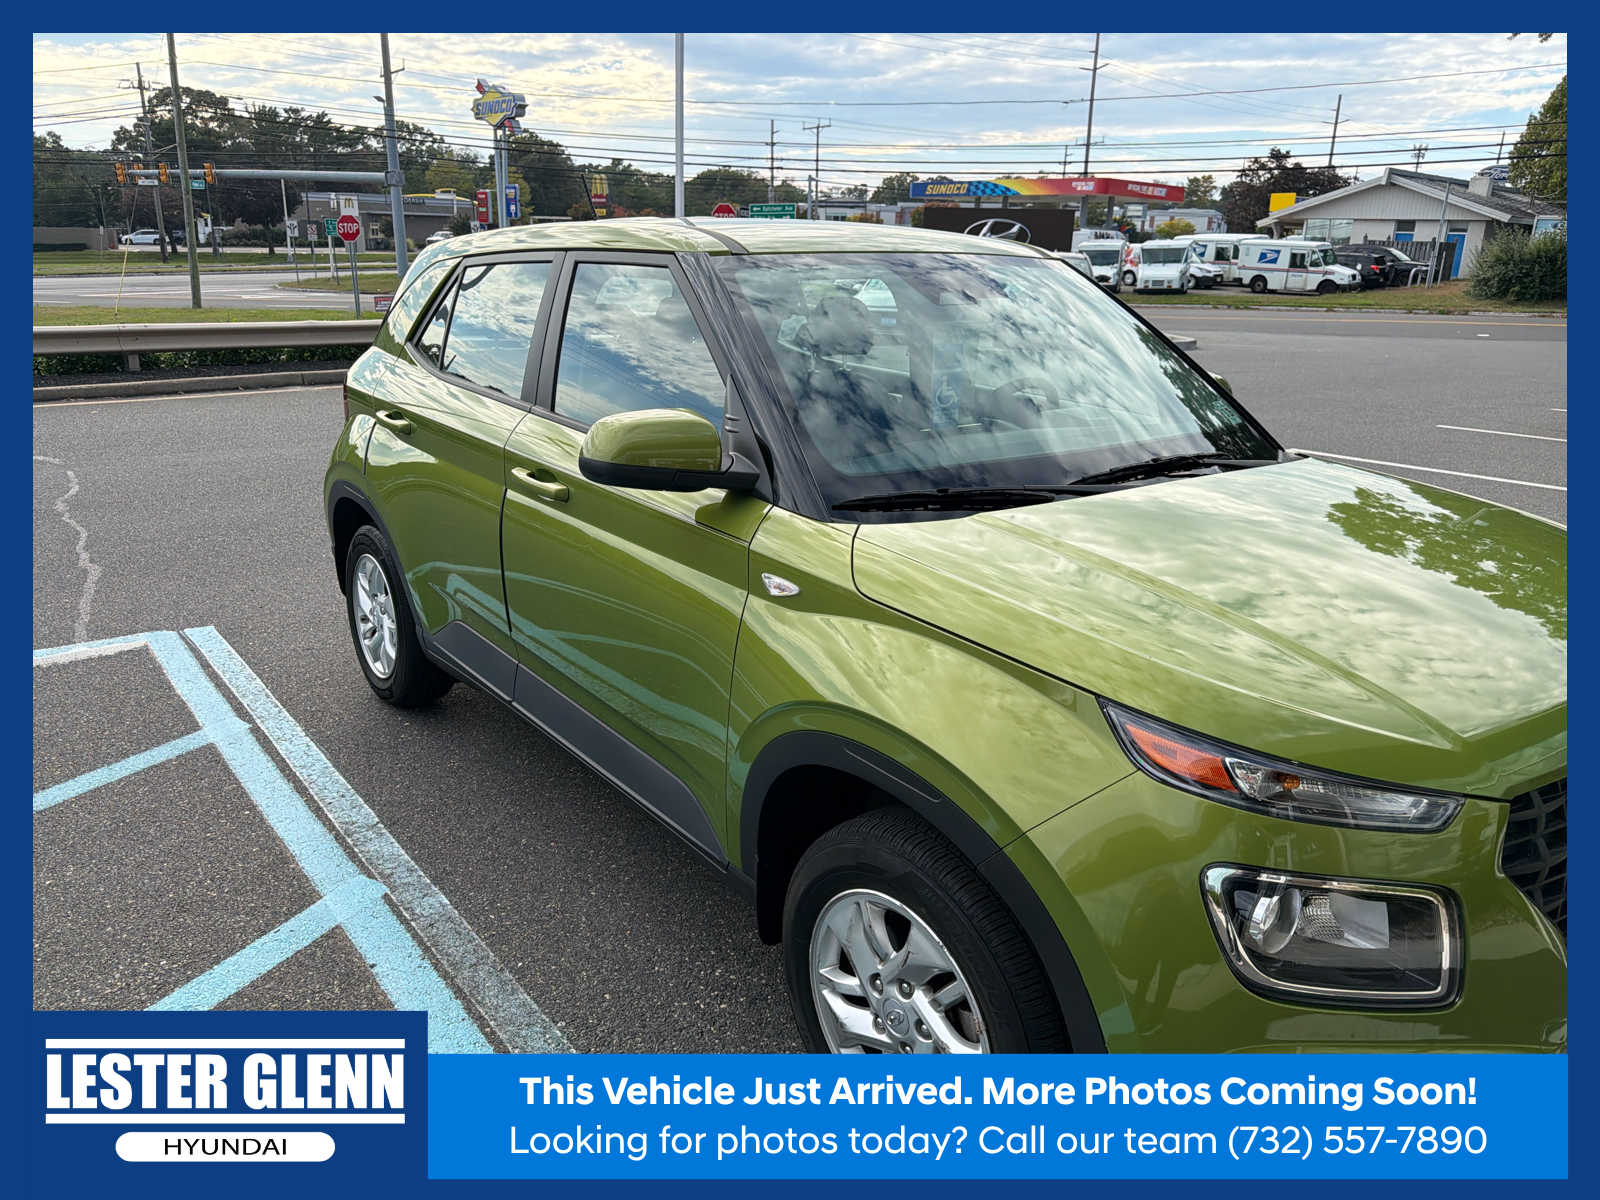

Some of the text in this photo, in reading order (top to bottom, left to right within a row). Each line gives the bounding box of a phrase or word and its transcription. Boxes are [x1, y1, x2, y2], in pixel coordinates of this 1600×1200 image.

[475, 97, 513, 115] SUNOCO
[926, 183, 969, 195] SUNOCO
[338, 222, 359, 234] STOP
